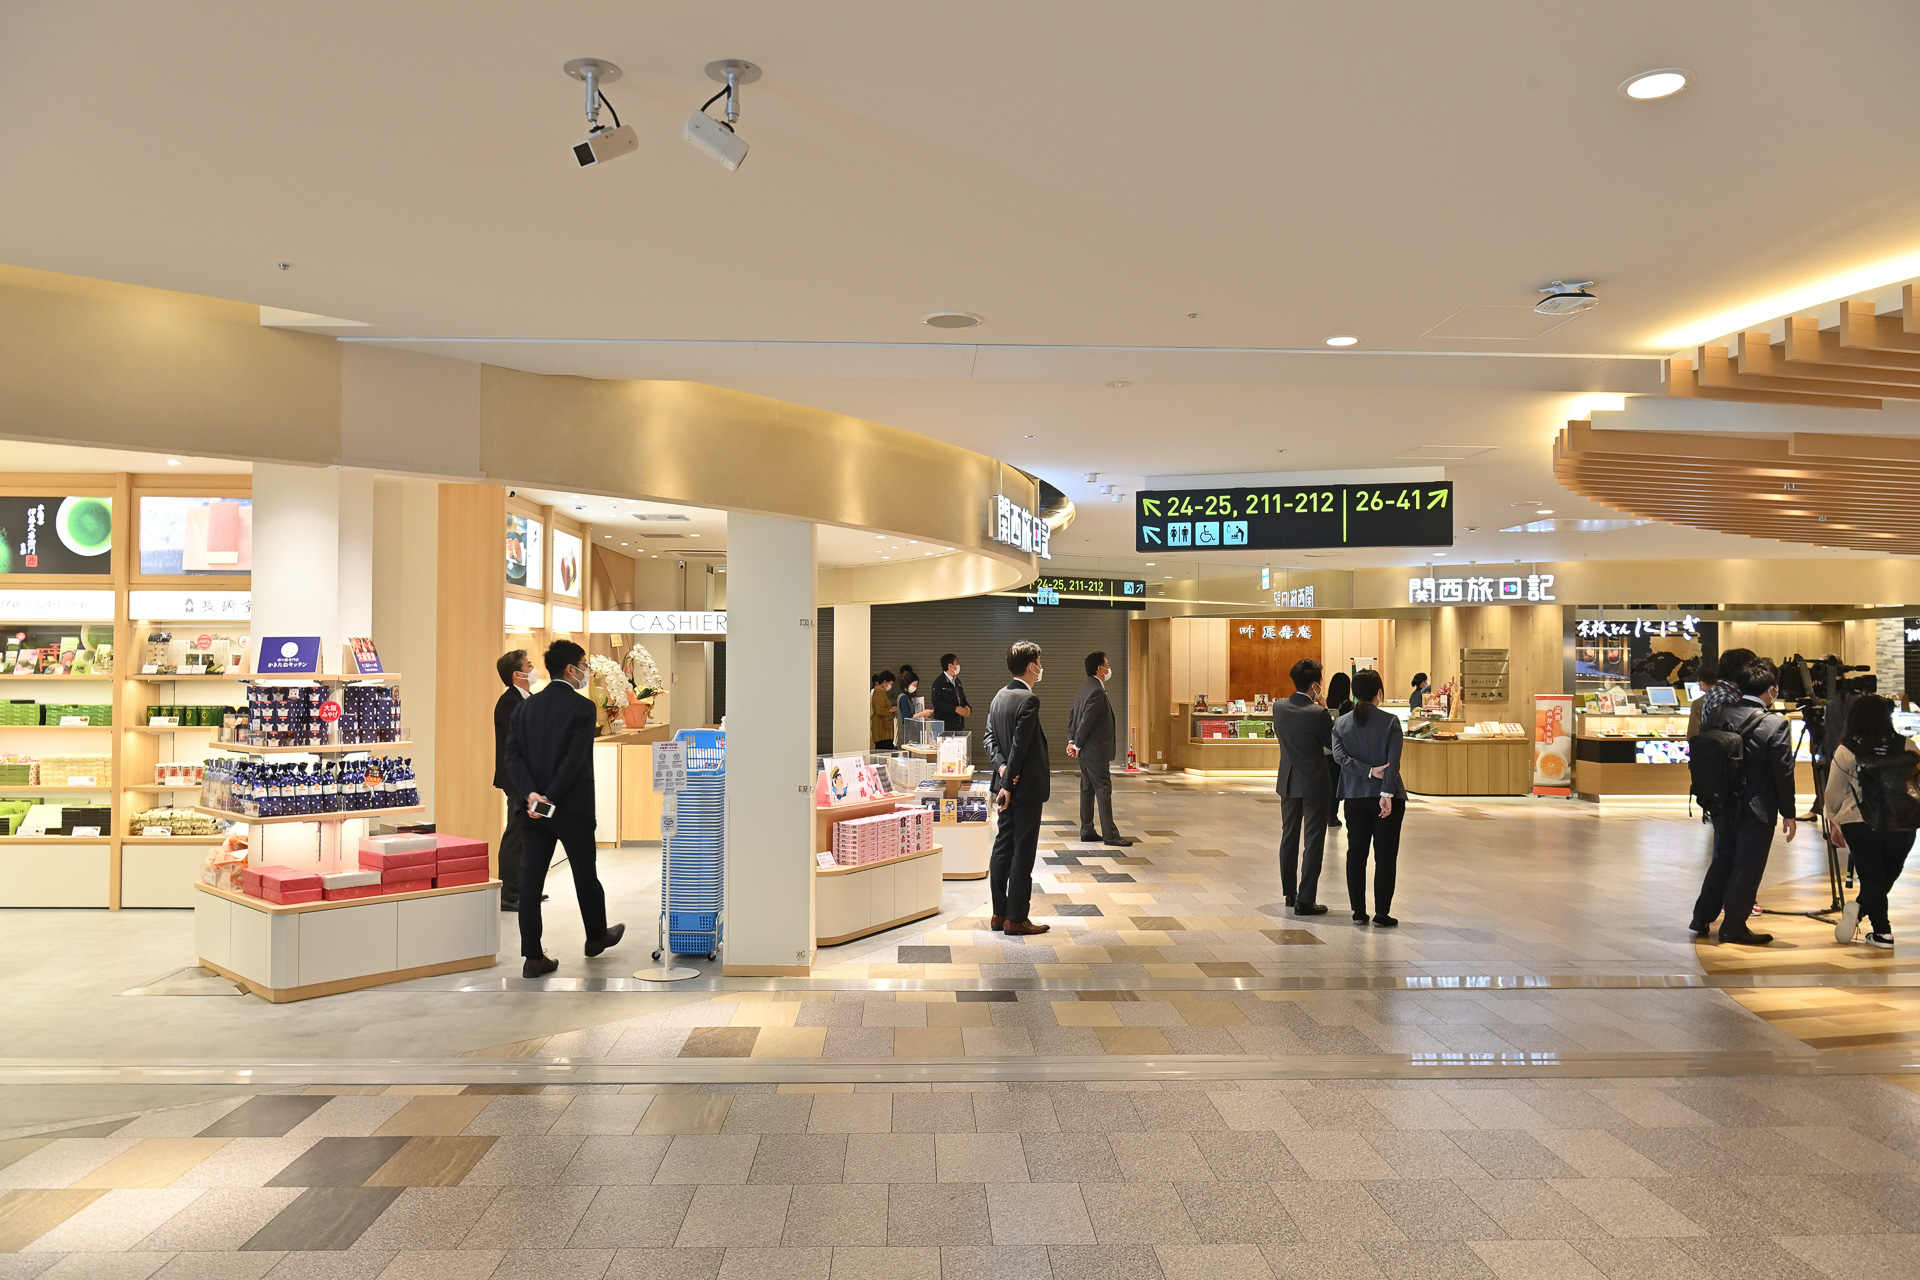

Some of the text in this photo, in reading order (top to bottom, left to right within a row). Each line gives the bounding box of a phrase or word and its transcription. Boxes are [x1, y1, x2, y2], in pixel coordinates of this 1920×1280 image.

[1167, 489, 1422, 518] 24-25, 211-212 26-41
[997, 494, 1052, 560] 関西旅日記
[1069, 579, 1104, 592] 211-212
[1408, 574, 1556, 604] 関西旅日記
[629, 613, 728, 632] CASHIER
